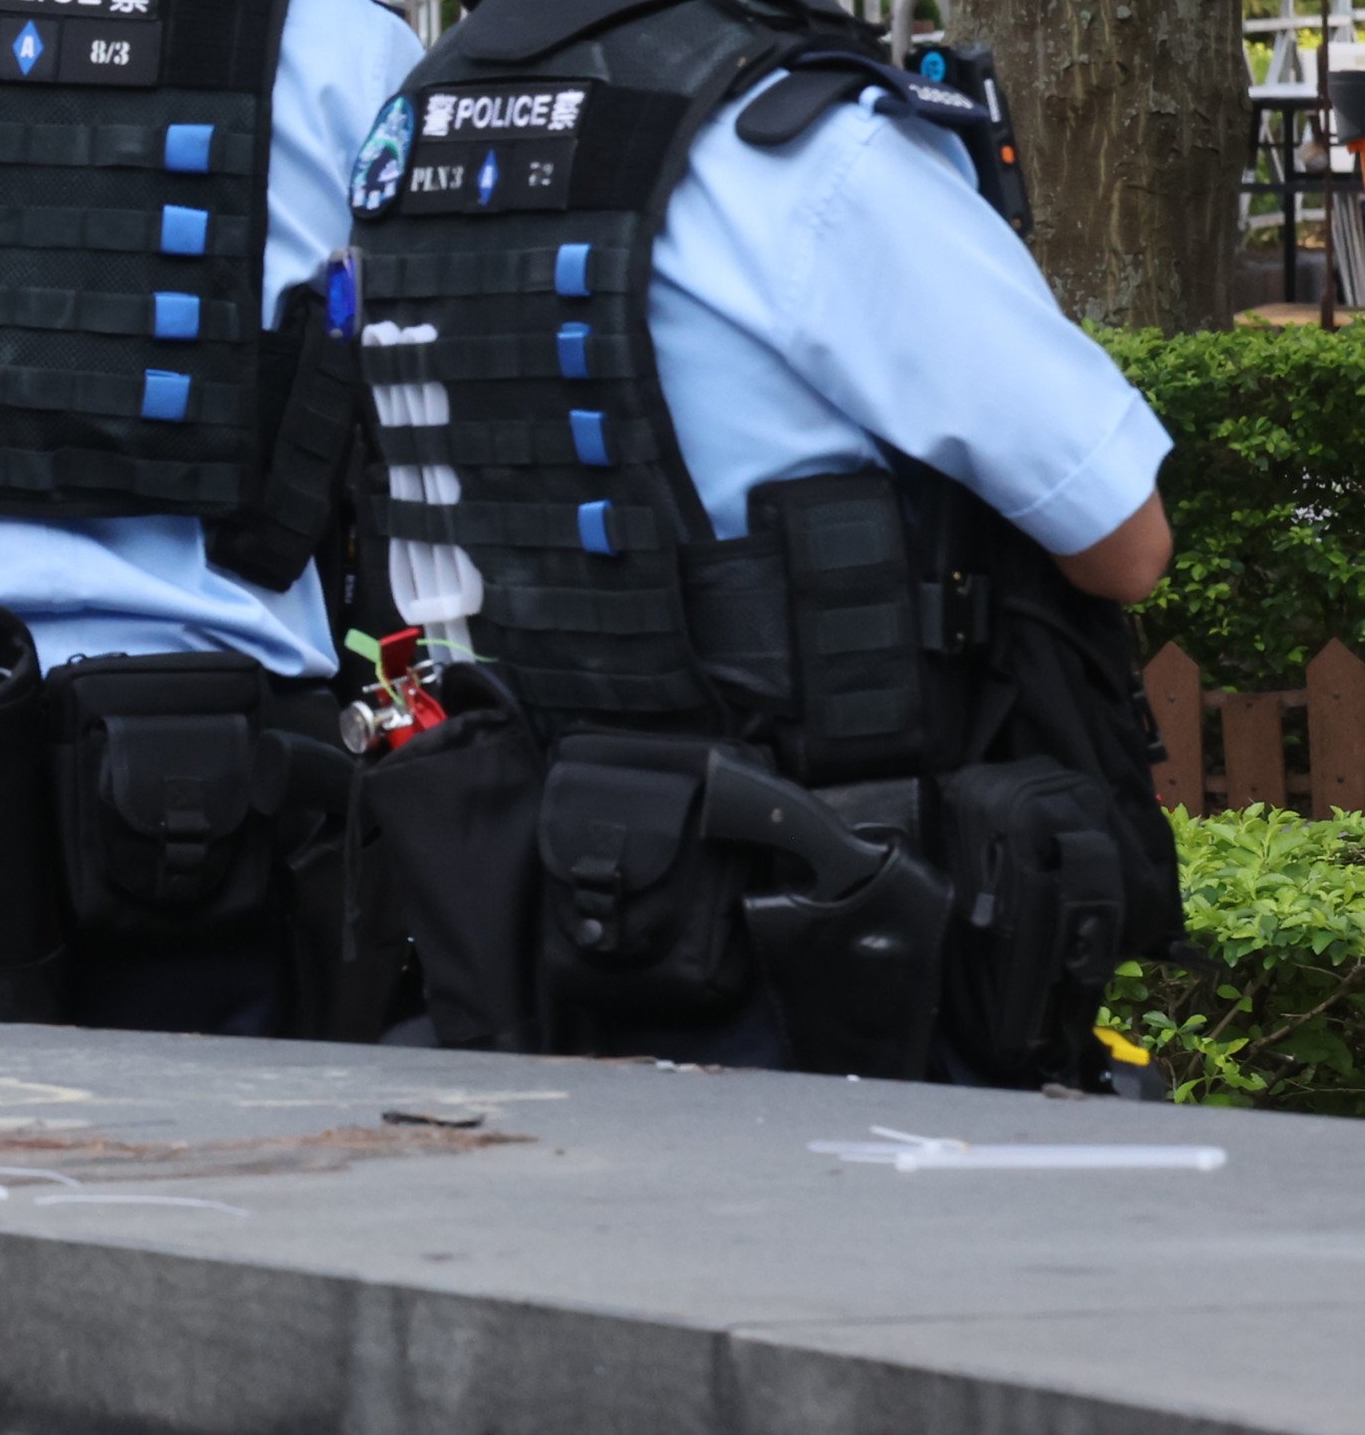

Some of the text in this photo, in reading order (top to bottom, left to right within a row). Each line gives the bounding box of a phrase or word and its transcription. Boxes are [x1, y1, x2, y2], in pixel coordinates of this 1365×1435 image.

[20, 36, 35, 58] A
[90, 39, 131, 66] 8/3
[454, 95, 553, 130] POLICE
